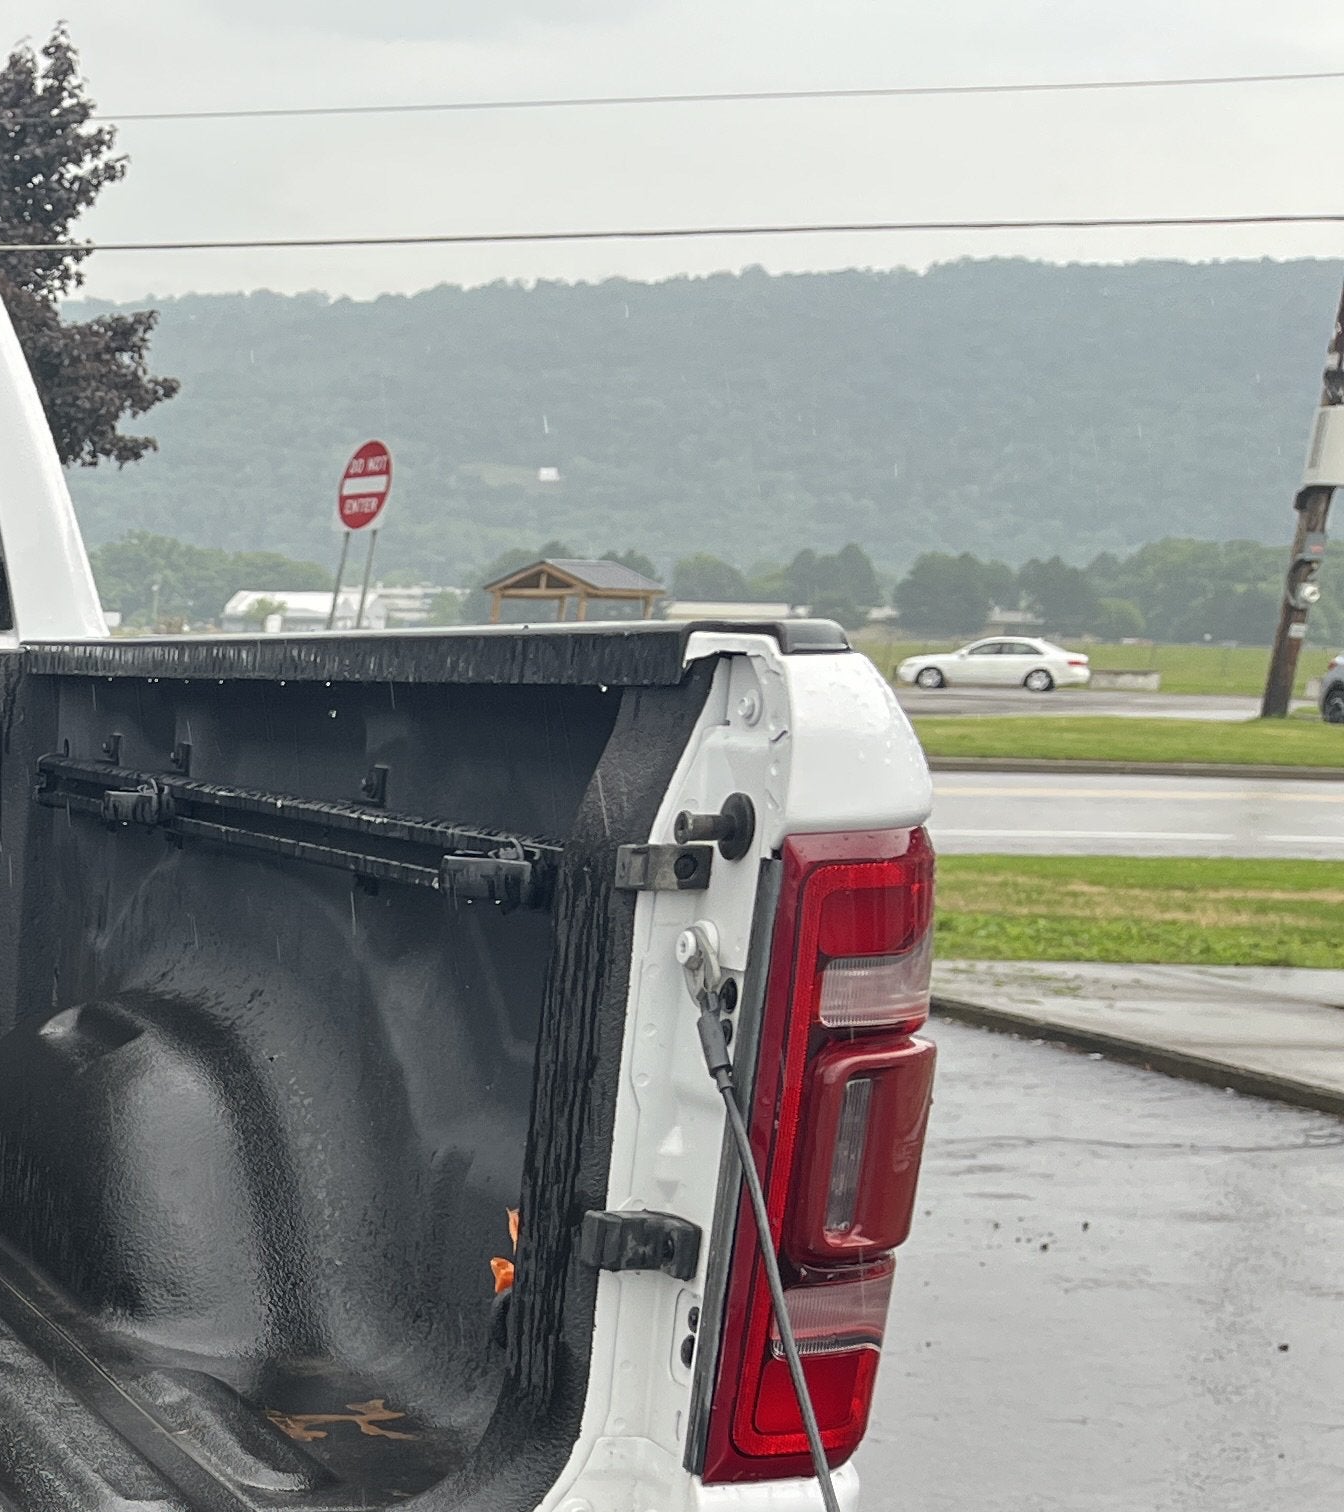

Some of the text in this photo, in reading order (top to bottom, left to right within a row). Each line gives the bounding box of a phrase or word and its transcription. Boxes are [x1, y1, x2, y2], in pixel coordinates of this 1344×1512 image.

[350, 454, 387, 473] DO NOT
[344, 497, 378, 514] ENTER
